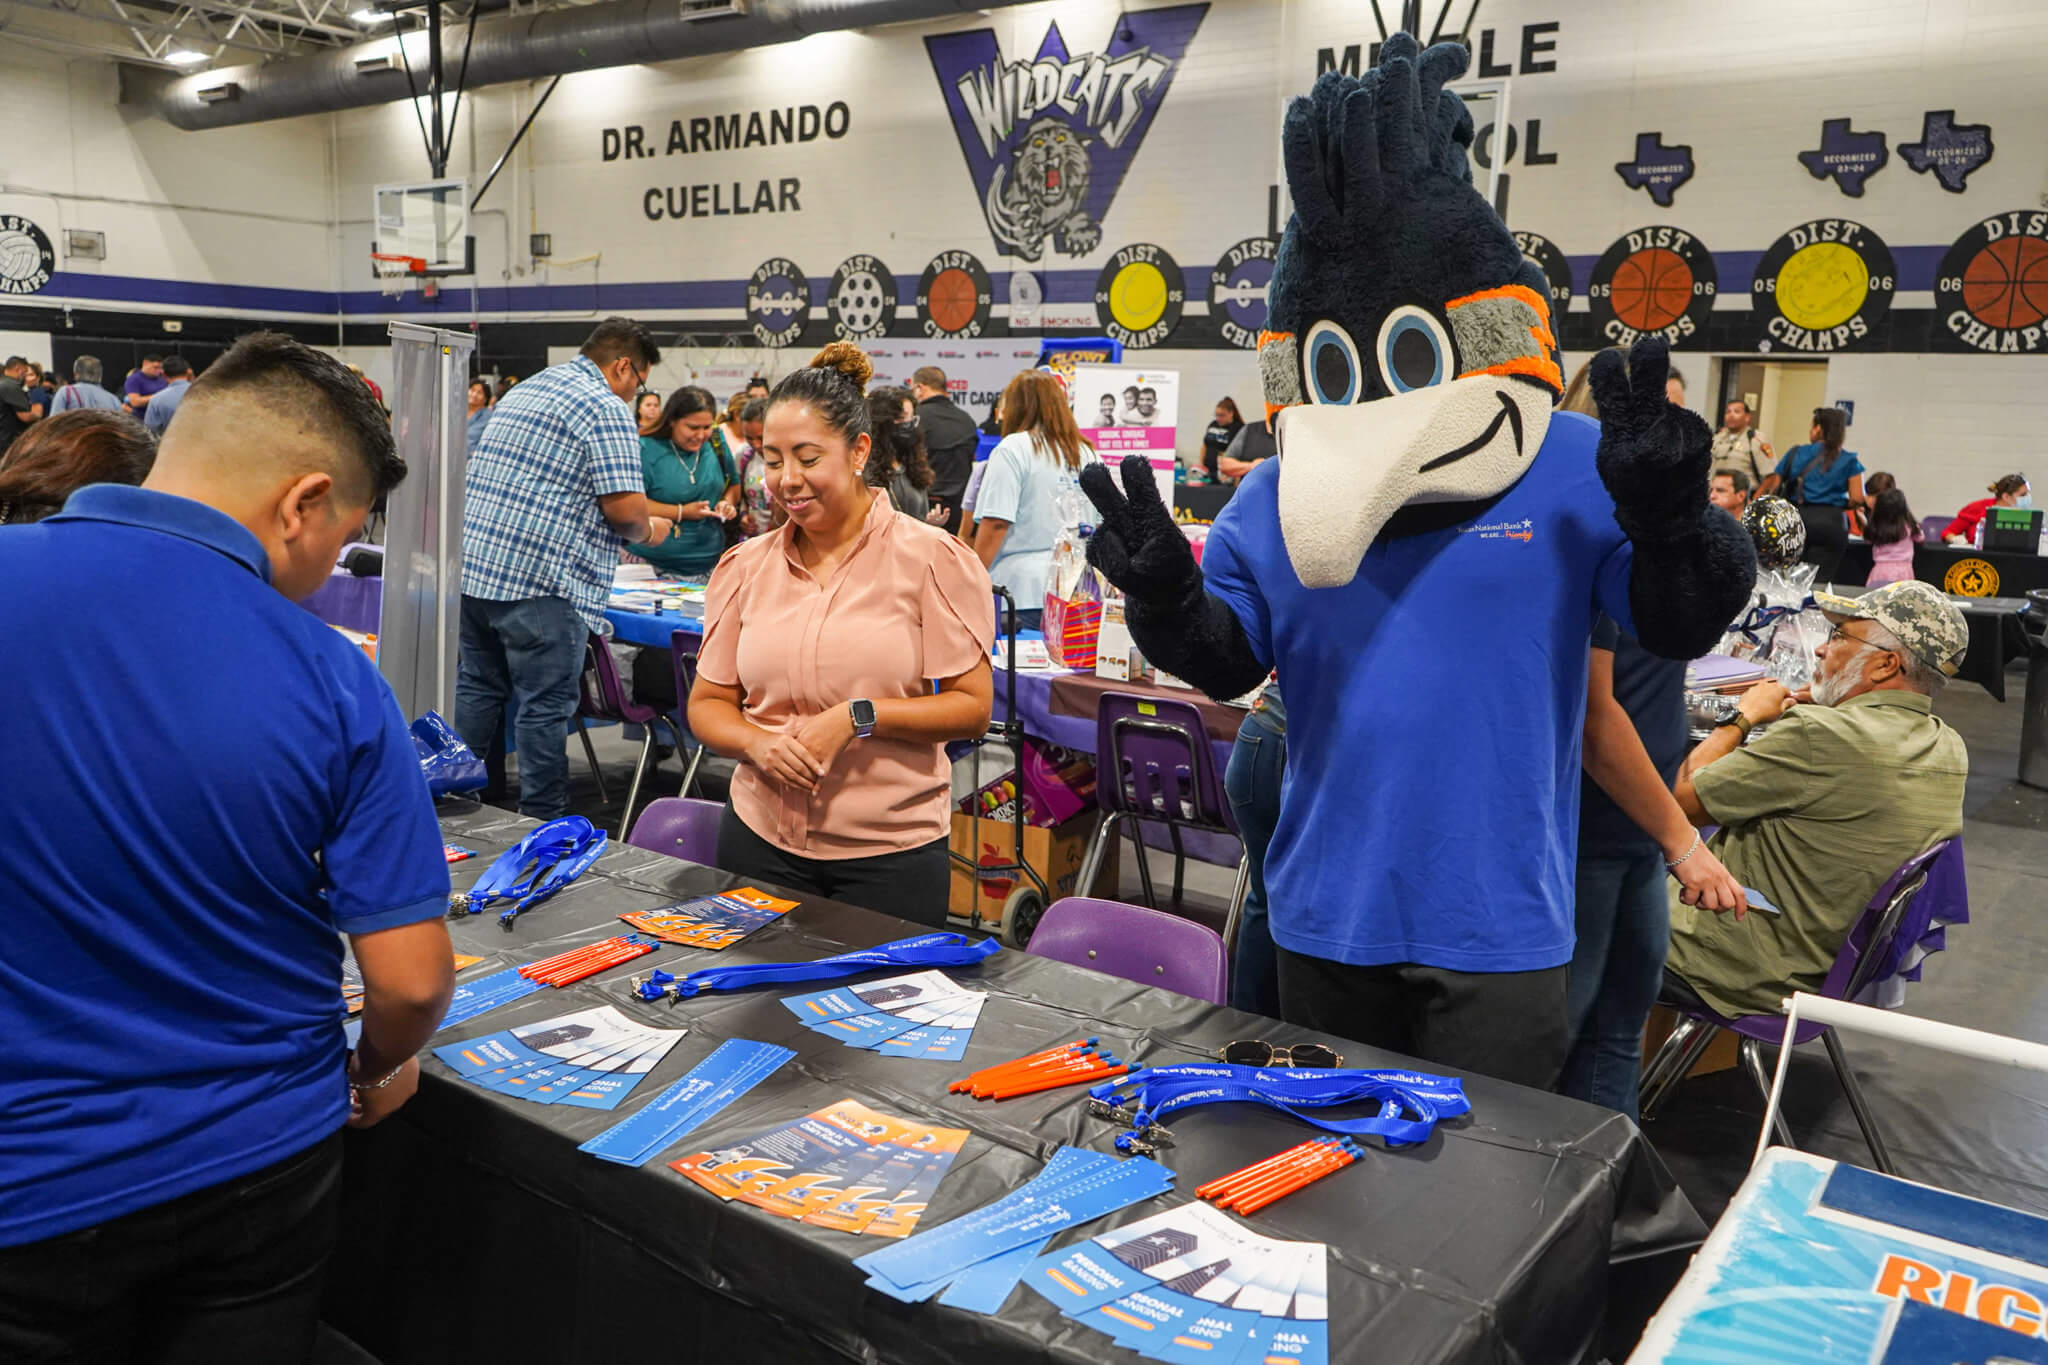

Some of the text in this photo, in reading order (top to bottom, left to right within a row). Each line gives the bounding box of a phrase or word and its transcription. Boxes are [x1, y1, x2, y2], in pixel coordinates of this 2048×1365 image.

[957, 47, 1174, 160] WILDCATS
[602, 100, 851, 162] DR. ARMANDO
[1823, 153, 1876, 164] RECOGNIZED
[643, 177, 802, 221] CUELLAR
[1789, 220, 1865, 250] DIST.
[1984, 212, 2048, 241] DIS
[1515, 233, 1548, 259] ST.
[1627, 228, 1693, 258] DIST.
[839, 256, 877, 280] DIST.
[932, 252, 975, 274] DIST.
[1117, 246, 1161, 268] DIST.
[757, 260, 795, 282] DIST.
[1754, 276, 1893, 293] 05 06
[1940, 277, 1962, 291] 06
[1590, 282, 1715, 297] 05 06
[753, 322, 801, 348] CHAMPS
[1015, 316, 1093, 327] NO SMOKING
[1106, 321, 1169, 349] CHAMPS
[1221, 321, 1258, 348] CHA
[1605, 314, 1696, 347] CHPS
[1768, 315, 1868, 351] CHAMPS
[1475, 523, 1503, 532] National
[1504, 521, 1522, 530] Bank
[1061, 1259, 1109, 1292] BANKING
[1071, 1251, 1125, 1289] PERSONAL
[1130, 1292, 1184, 1319] RSONAL
[1873, 1252, 2048, 1344] RIC
